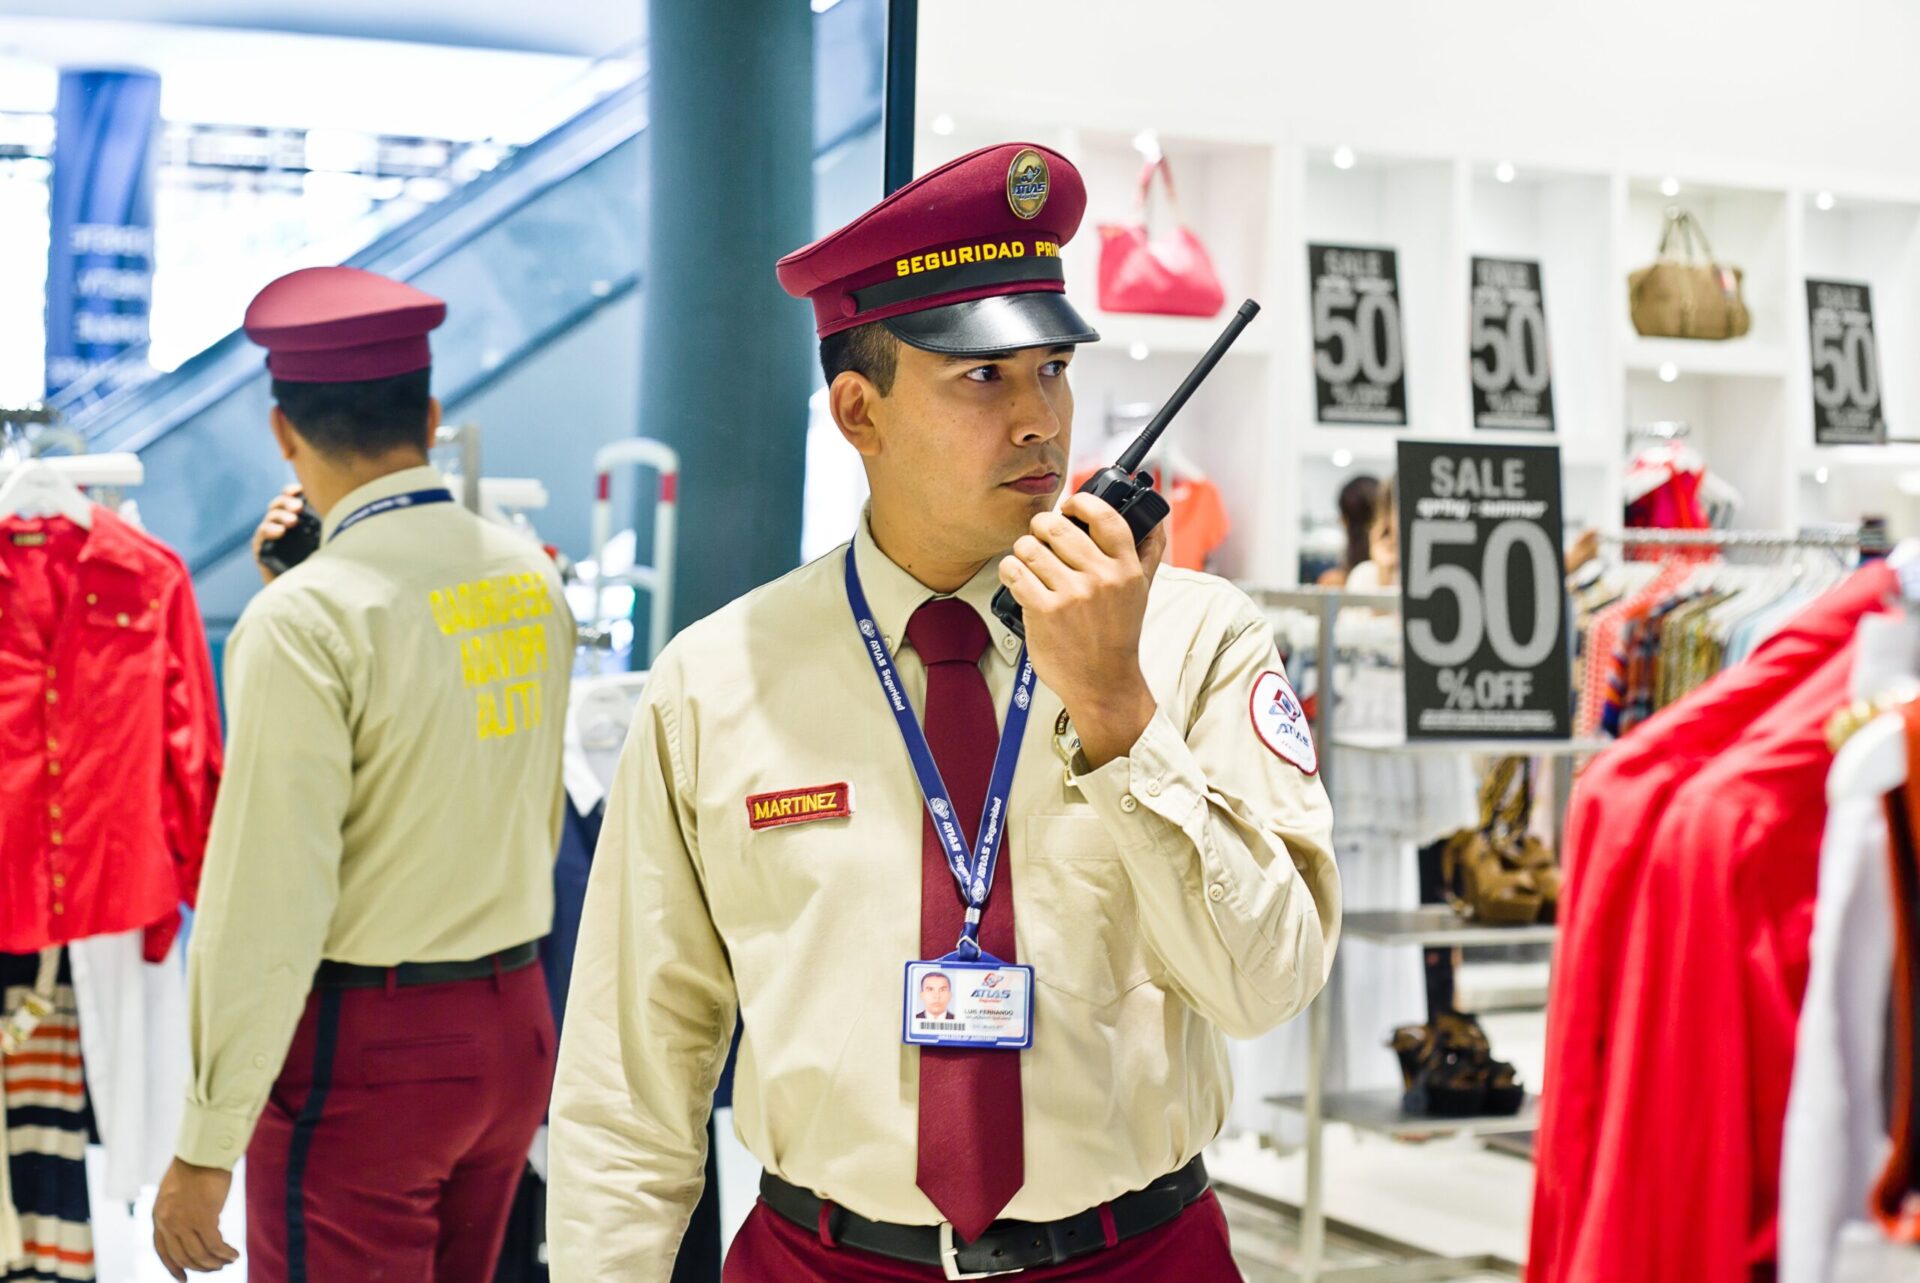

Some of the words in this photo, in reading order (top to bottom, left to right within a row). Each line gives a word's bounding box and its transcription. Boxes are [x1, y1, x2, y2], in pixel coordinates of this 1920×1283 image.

[1012, 183, 1047, 196] ATLAS
[896, 241, 1024, 277] SEGURIDAD
[1313, 286, 1402, 386] 50
[1471, 298, 1550, 394] 50
[1812, 322, 1879, 411] 50
[1430, 455, 1527, 498] SALE
[1406, 519, 1560, 668] 50
[870, 639, 888, 668] ATLAS
[882, 668, 906, 712] Seguridad
[754, 791, 837, 821] MARTINEZ
[942, 820, 962, 852] ATLAS
[977, 845, 991, 880] ATLAS
[984, 796, 1002, 845] Seguridad
[971, 989, 1011, 999] ATLAS
